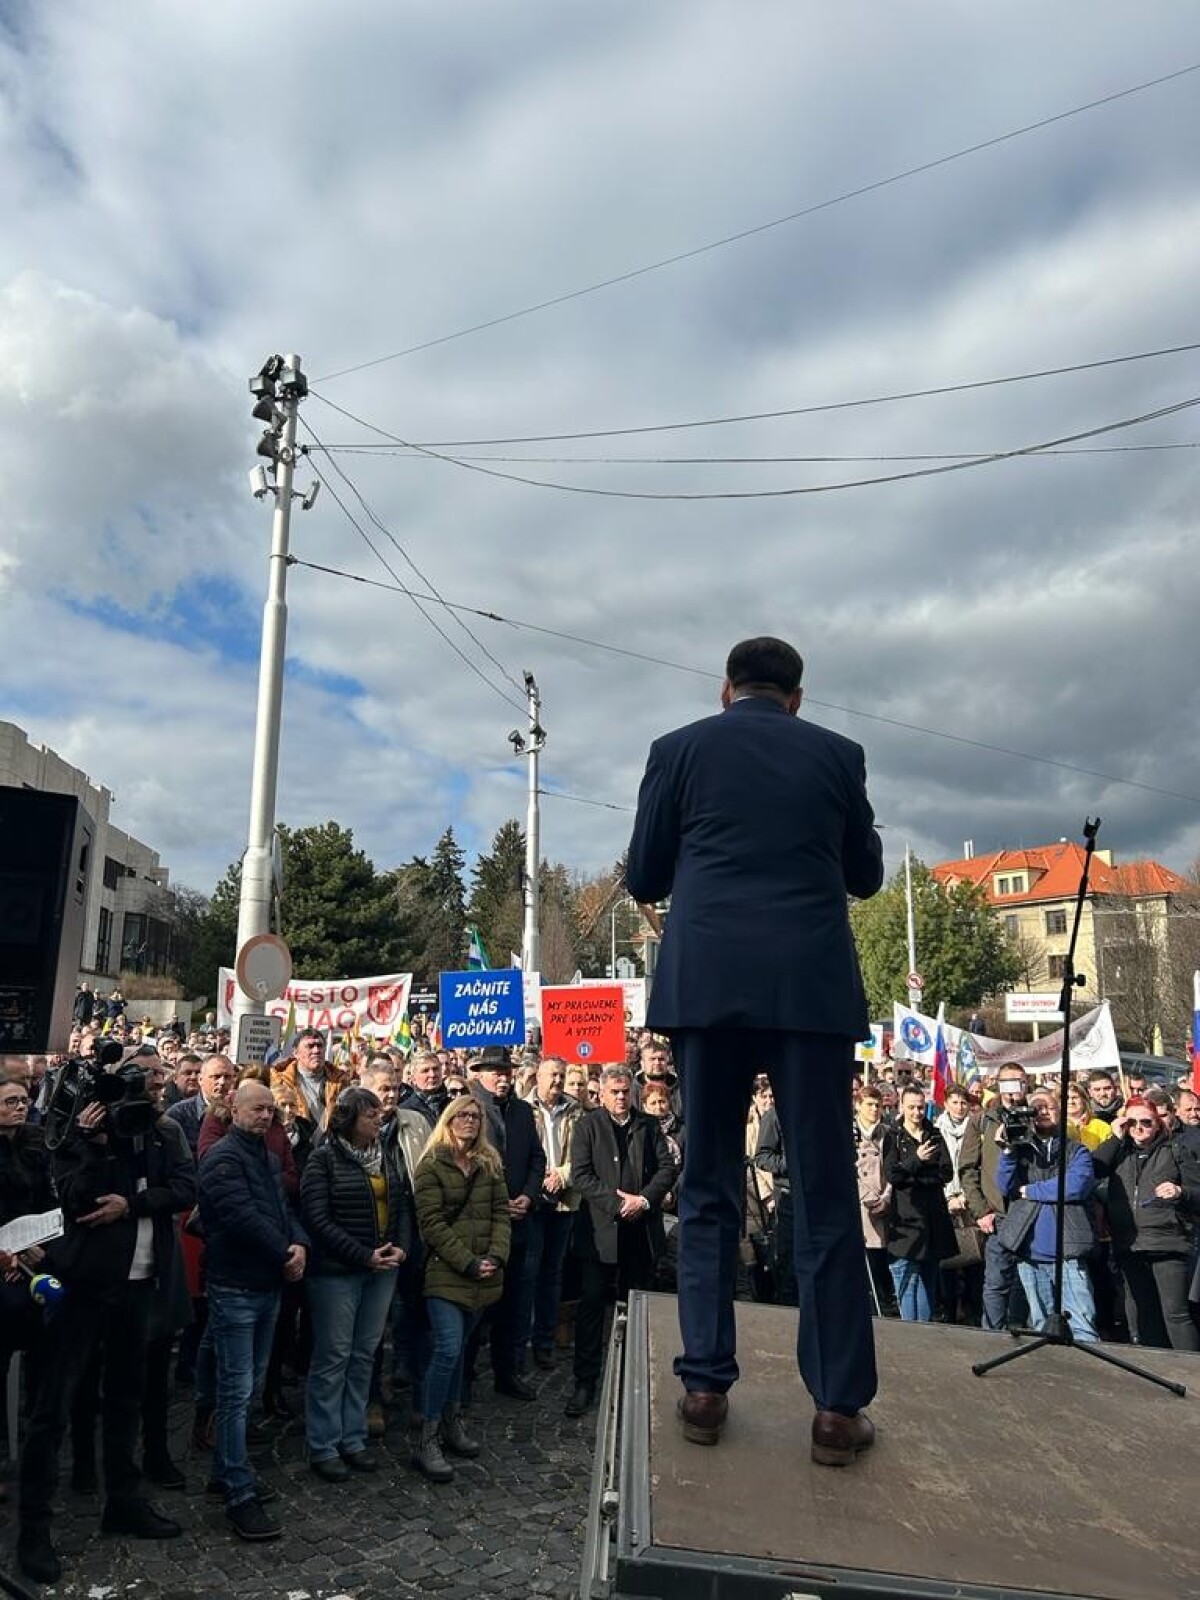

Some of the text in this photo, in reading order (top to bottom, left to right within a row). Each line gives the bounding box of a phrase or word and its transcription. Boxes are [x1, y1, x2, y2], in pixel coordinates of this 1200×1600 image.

[454, 979, 511, 998] ZAČNITE
[468, 998, 499, 1017] NÁS
[547, 1001, 562, 1011] MY
[565, 999, 618, 1010] PRACUJEME
[271, 1002, 356, 1031] SIAČ
[550, 1013, 570, 1024] PRE
[565, 1027, 573, 1037] A
